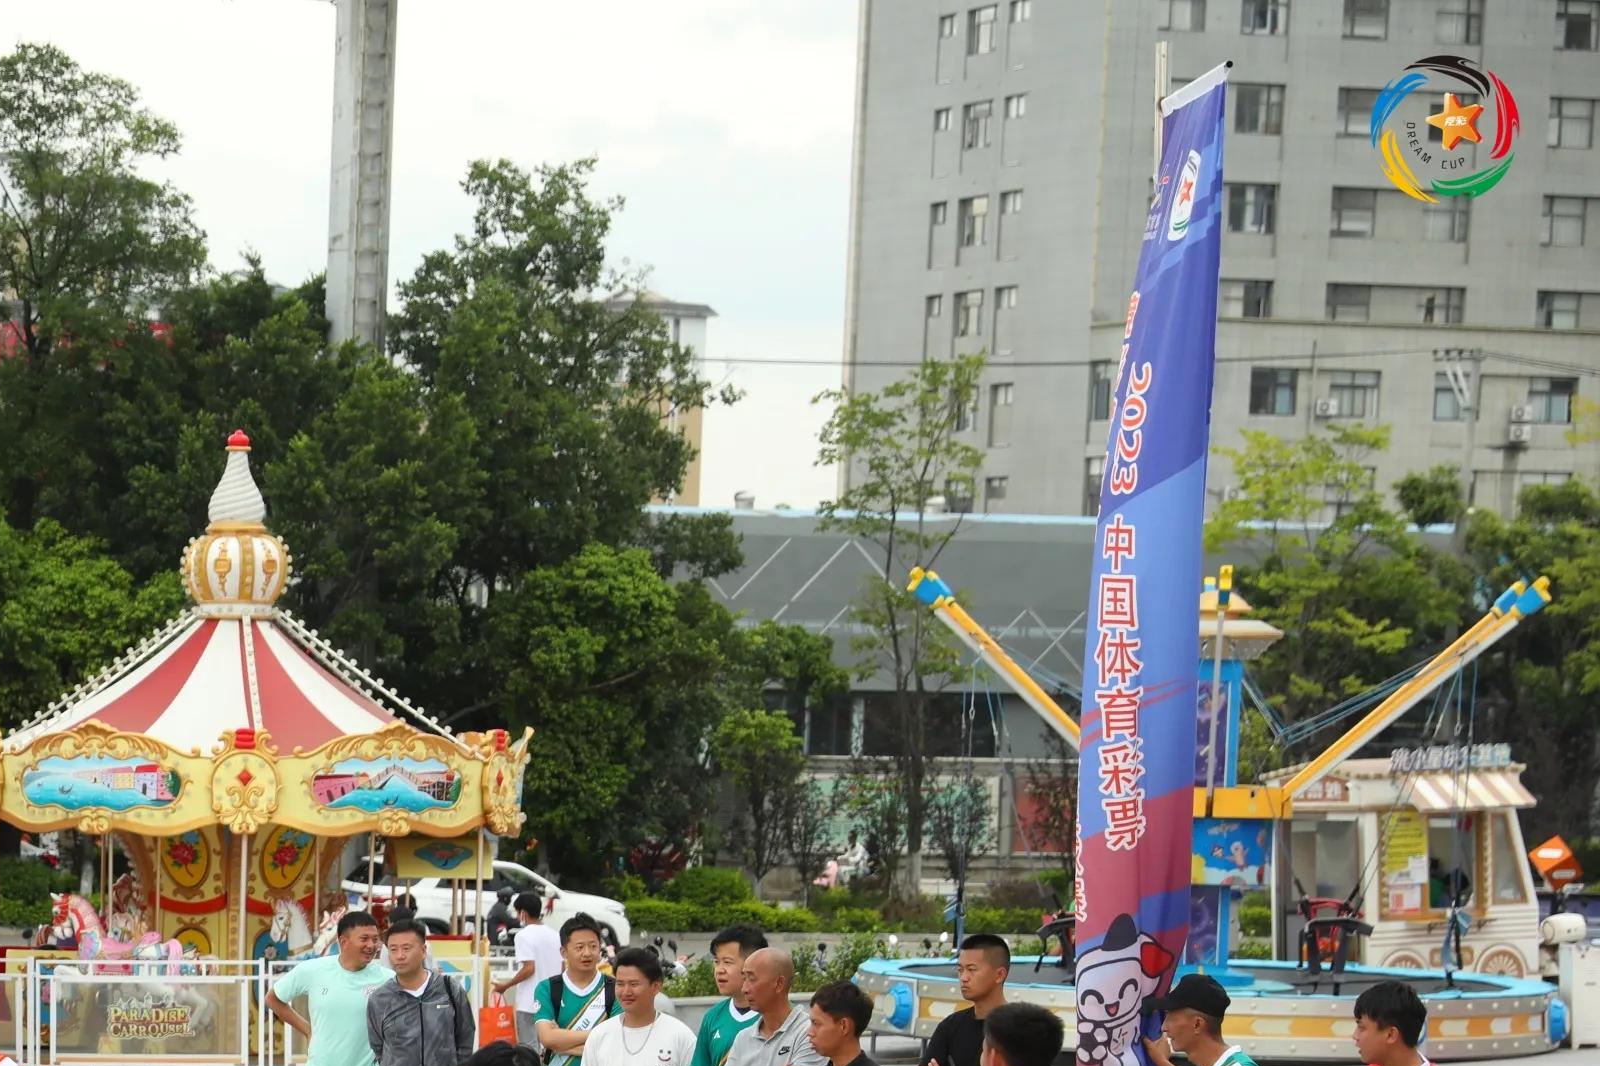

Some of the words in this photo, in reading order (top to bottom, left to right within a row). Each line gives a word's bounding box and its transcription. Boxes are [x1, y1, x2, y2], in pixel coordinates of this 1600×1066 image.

[1111, 361, 1152, 494] 2023
[1095, 513, 1144, 851] 中国体育彩票
[111, 1007, 188, 1023] PARADISE
[111, 1022, 193, 1037] CARROUSEL
